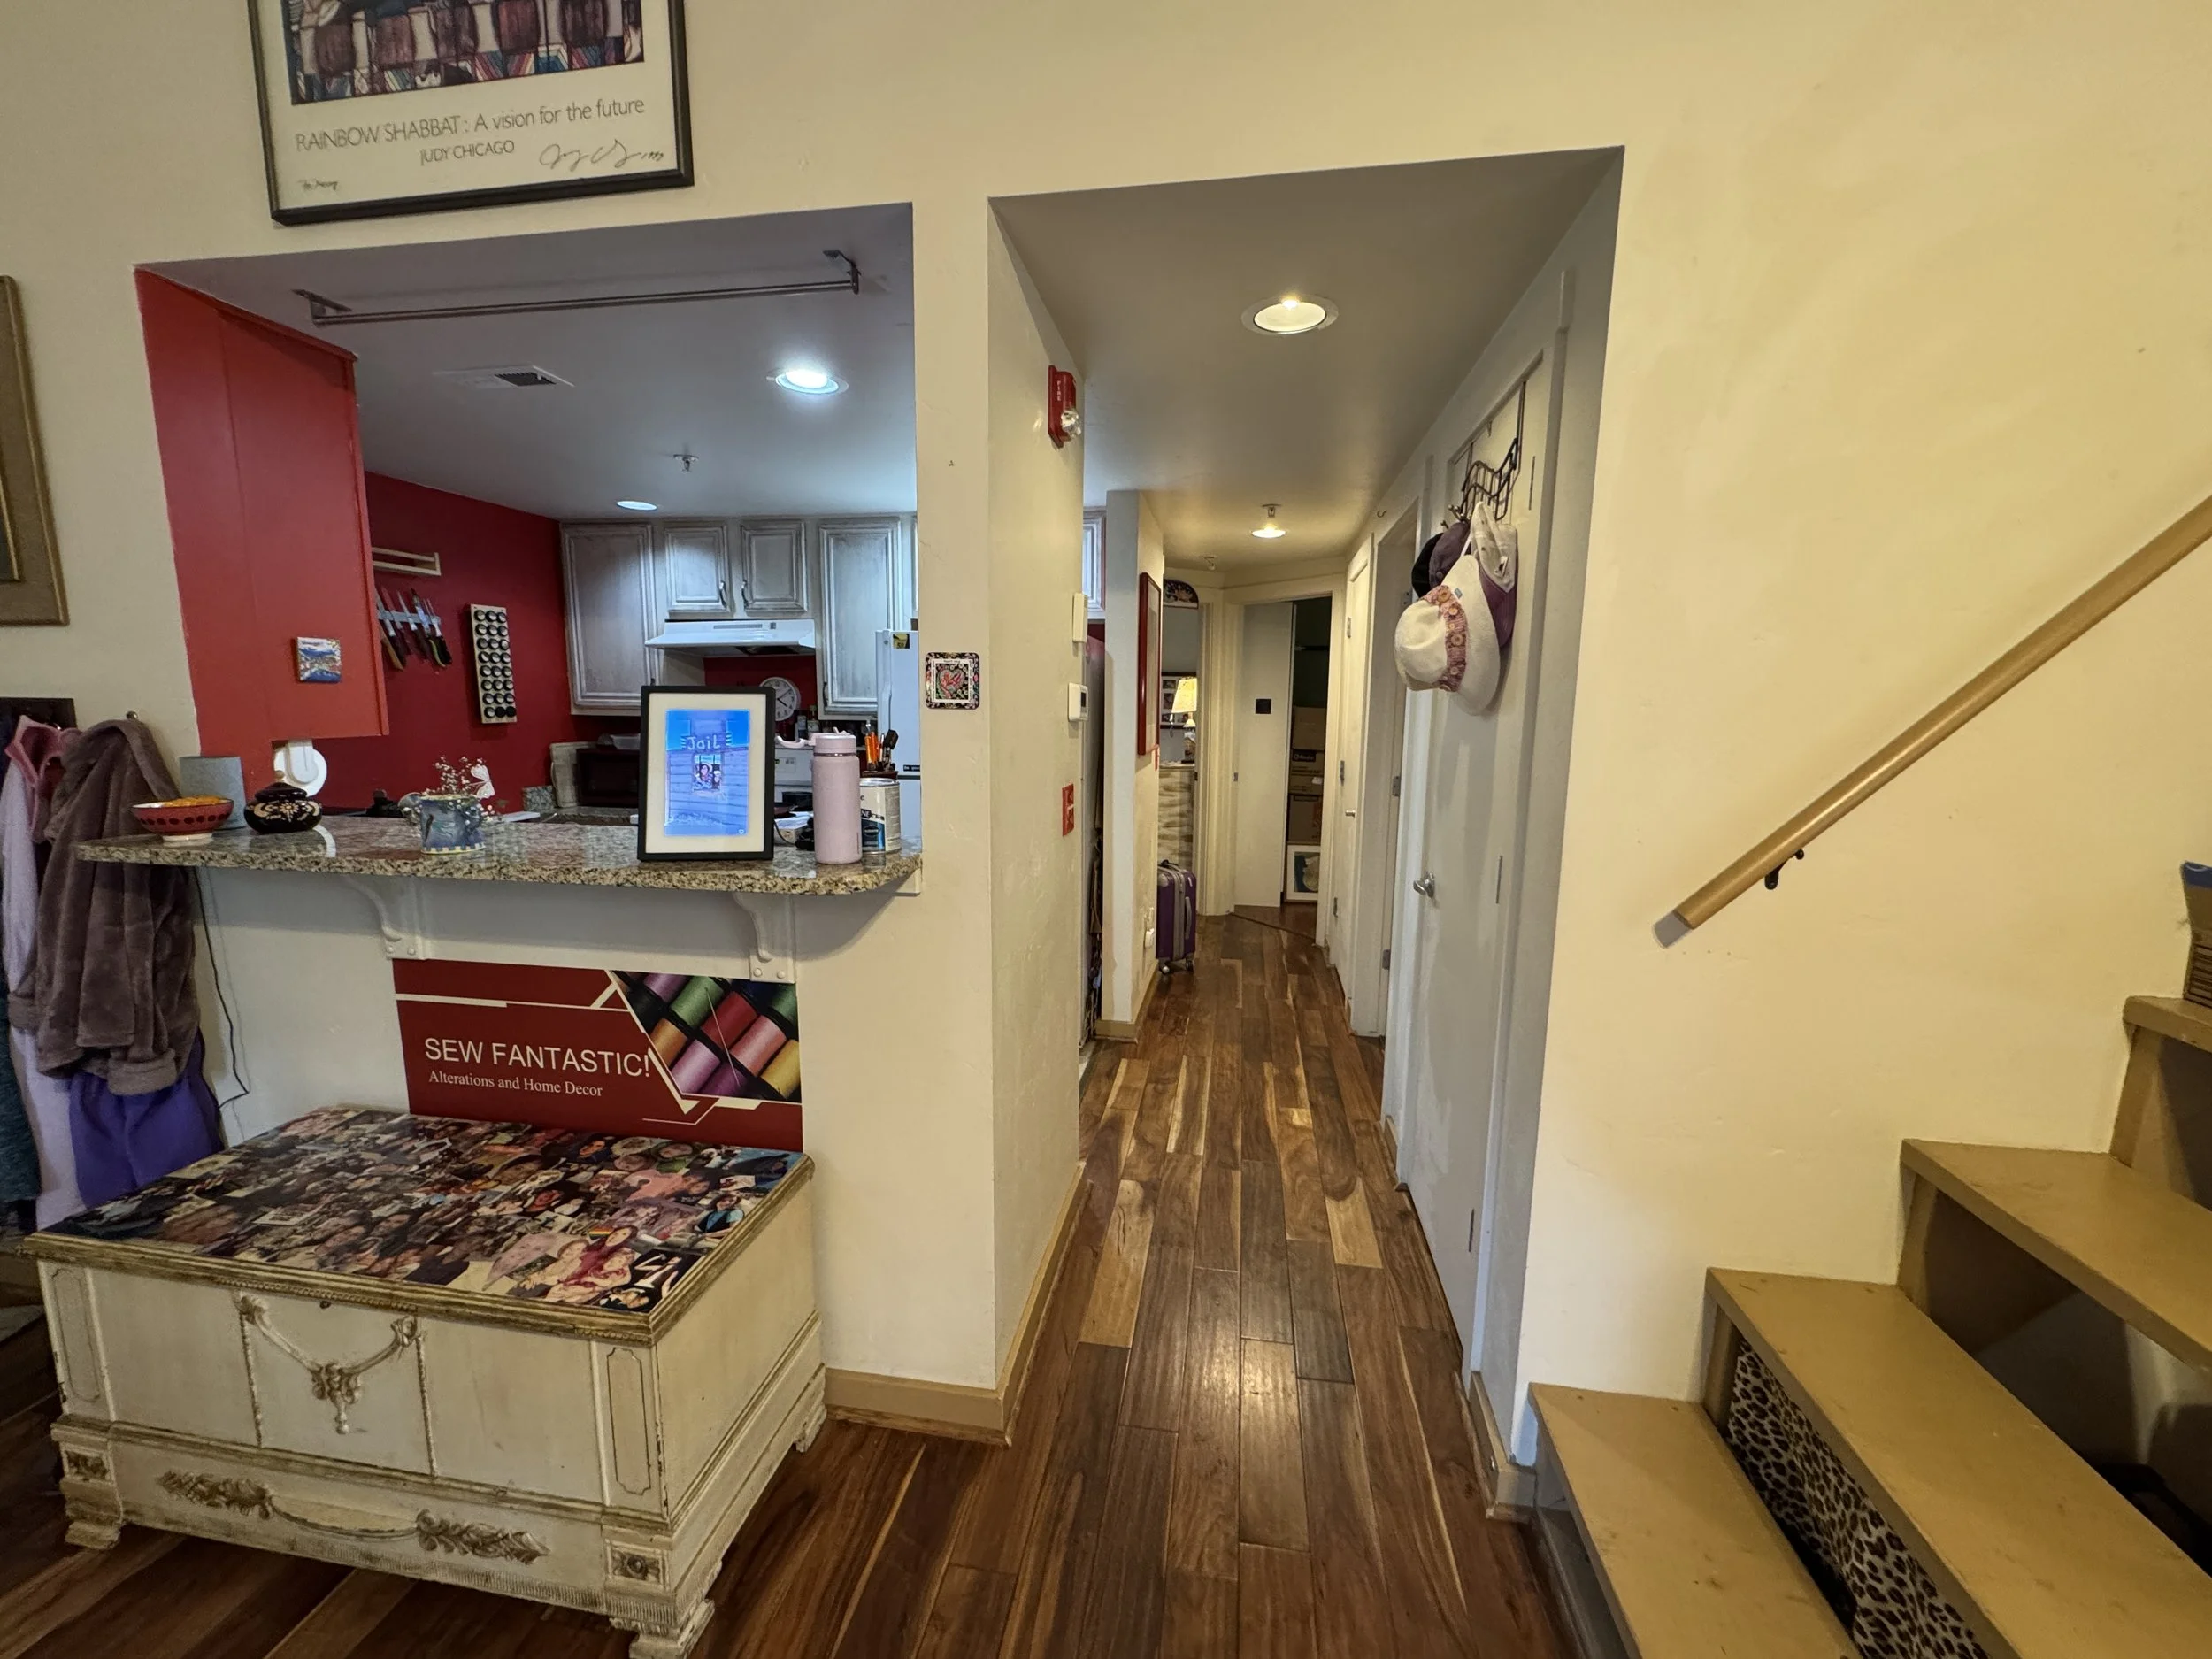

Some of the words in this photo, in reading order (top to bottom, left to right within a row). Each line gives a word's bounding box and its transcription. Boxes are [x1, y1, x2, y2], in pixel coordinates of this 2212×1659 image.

[296, 126, 380, 151] RAINBOW
[473, 113, 488, 132] A
[492, 109, 534, 130] vision
[540, 105, 561, 125] for
[566, 102, 592, 122] the
[596, 98, 645, 118] future
[420, 147, 449, 167] JUDY
[452, 140, 515, 159] CHICAGO
[425, 1037, 483, 1064] SEW
[492, 1042, 650, 1078] FANTASTIC!
[428, 1070, 495, 1087] Alterations
[498, 1076, 520, 1089] and
[524, 1078, 561, 1094] Home
[565, 1081, 603, 1097] Decor
